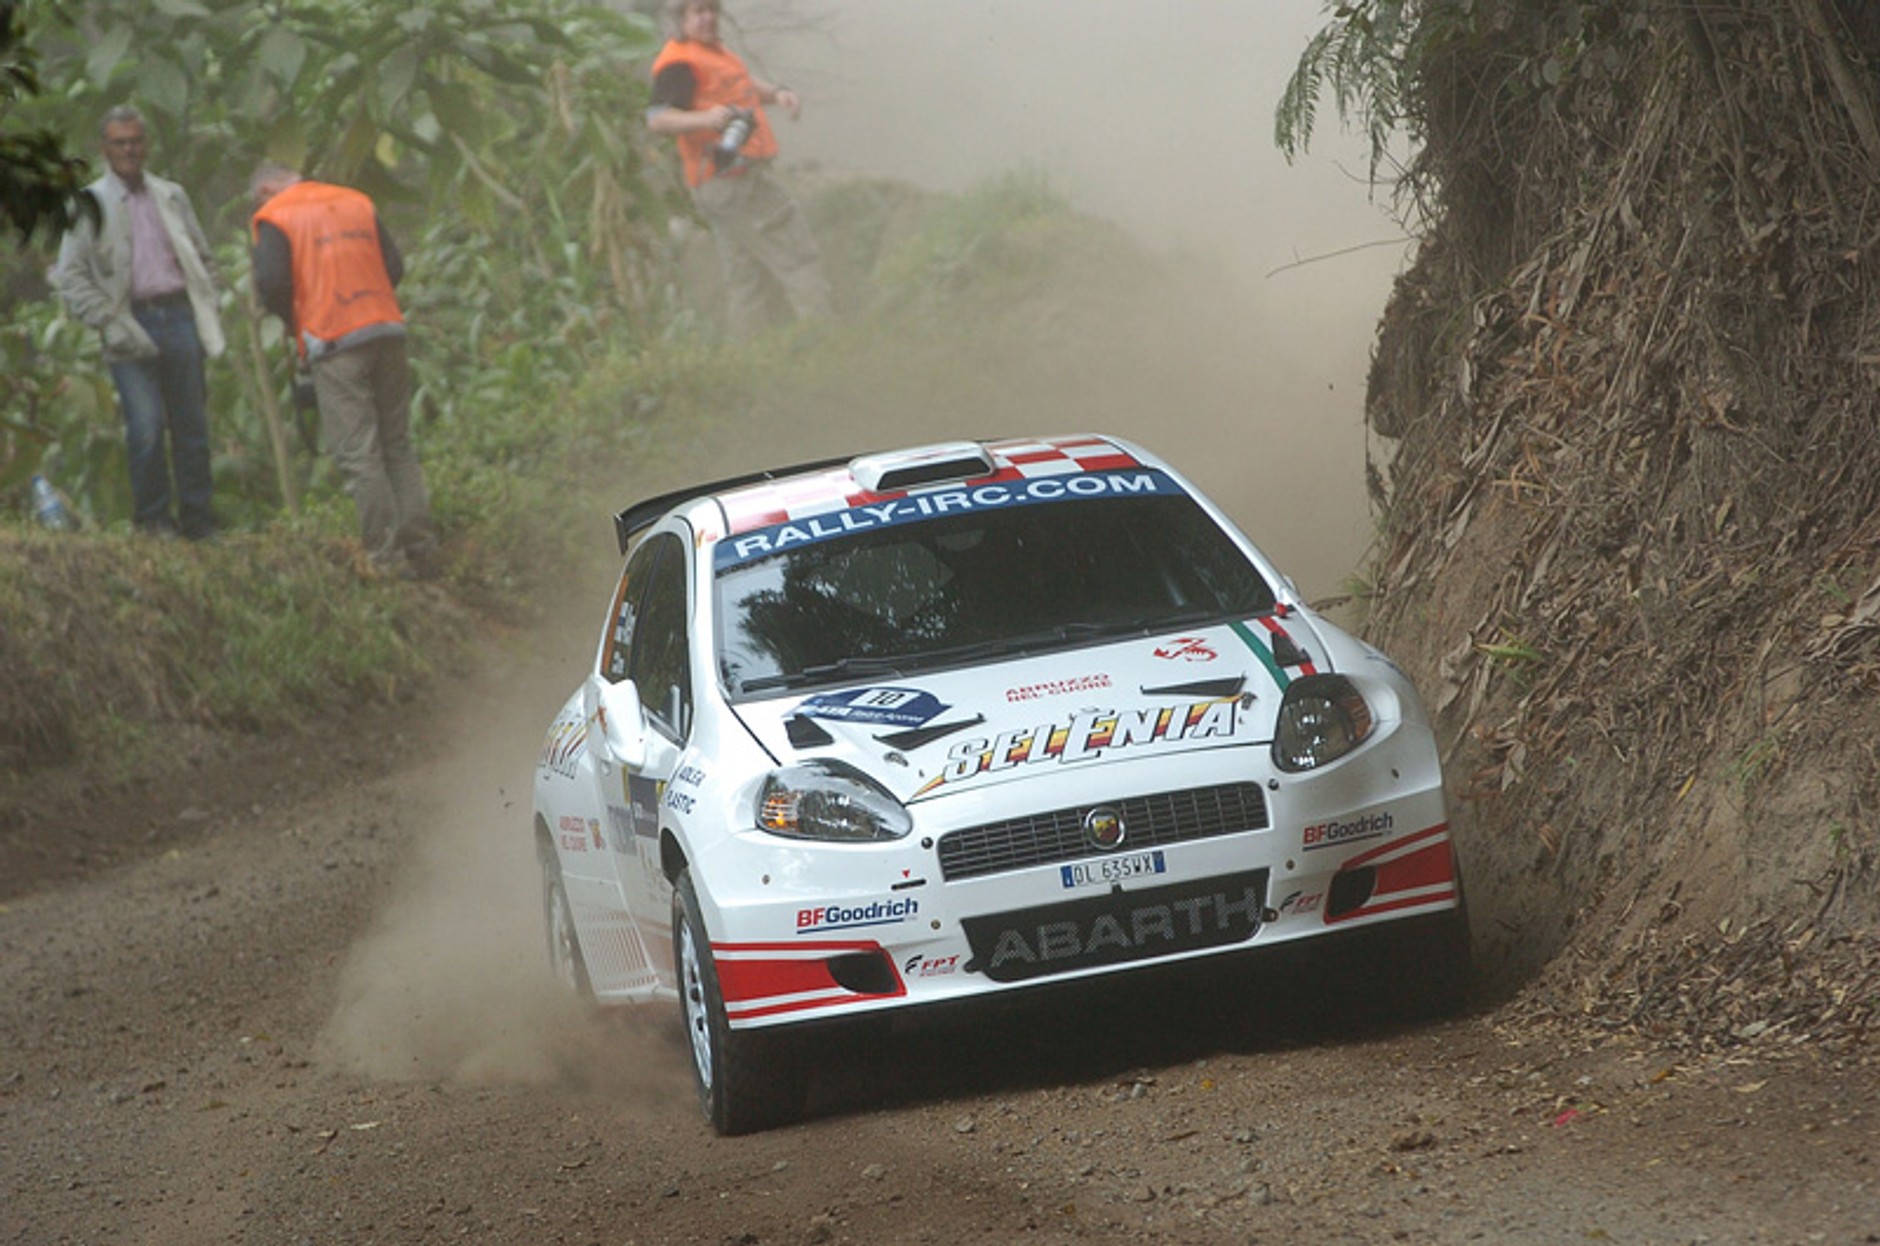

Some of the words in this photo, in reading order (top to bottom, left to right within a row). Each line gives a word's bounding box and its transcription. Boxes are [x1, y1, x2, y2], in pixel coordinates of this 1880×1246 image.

[733, 473, 1159, 559] RALLY-IRC.COM
[943, 698, 1238, 783] SELENIA
[1302, 811, 1393, 845] BFGoodrich
[796, 897, 919, 928] BFGoodrich
[989, 887, 1260, 970] ABARTH
